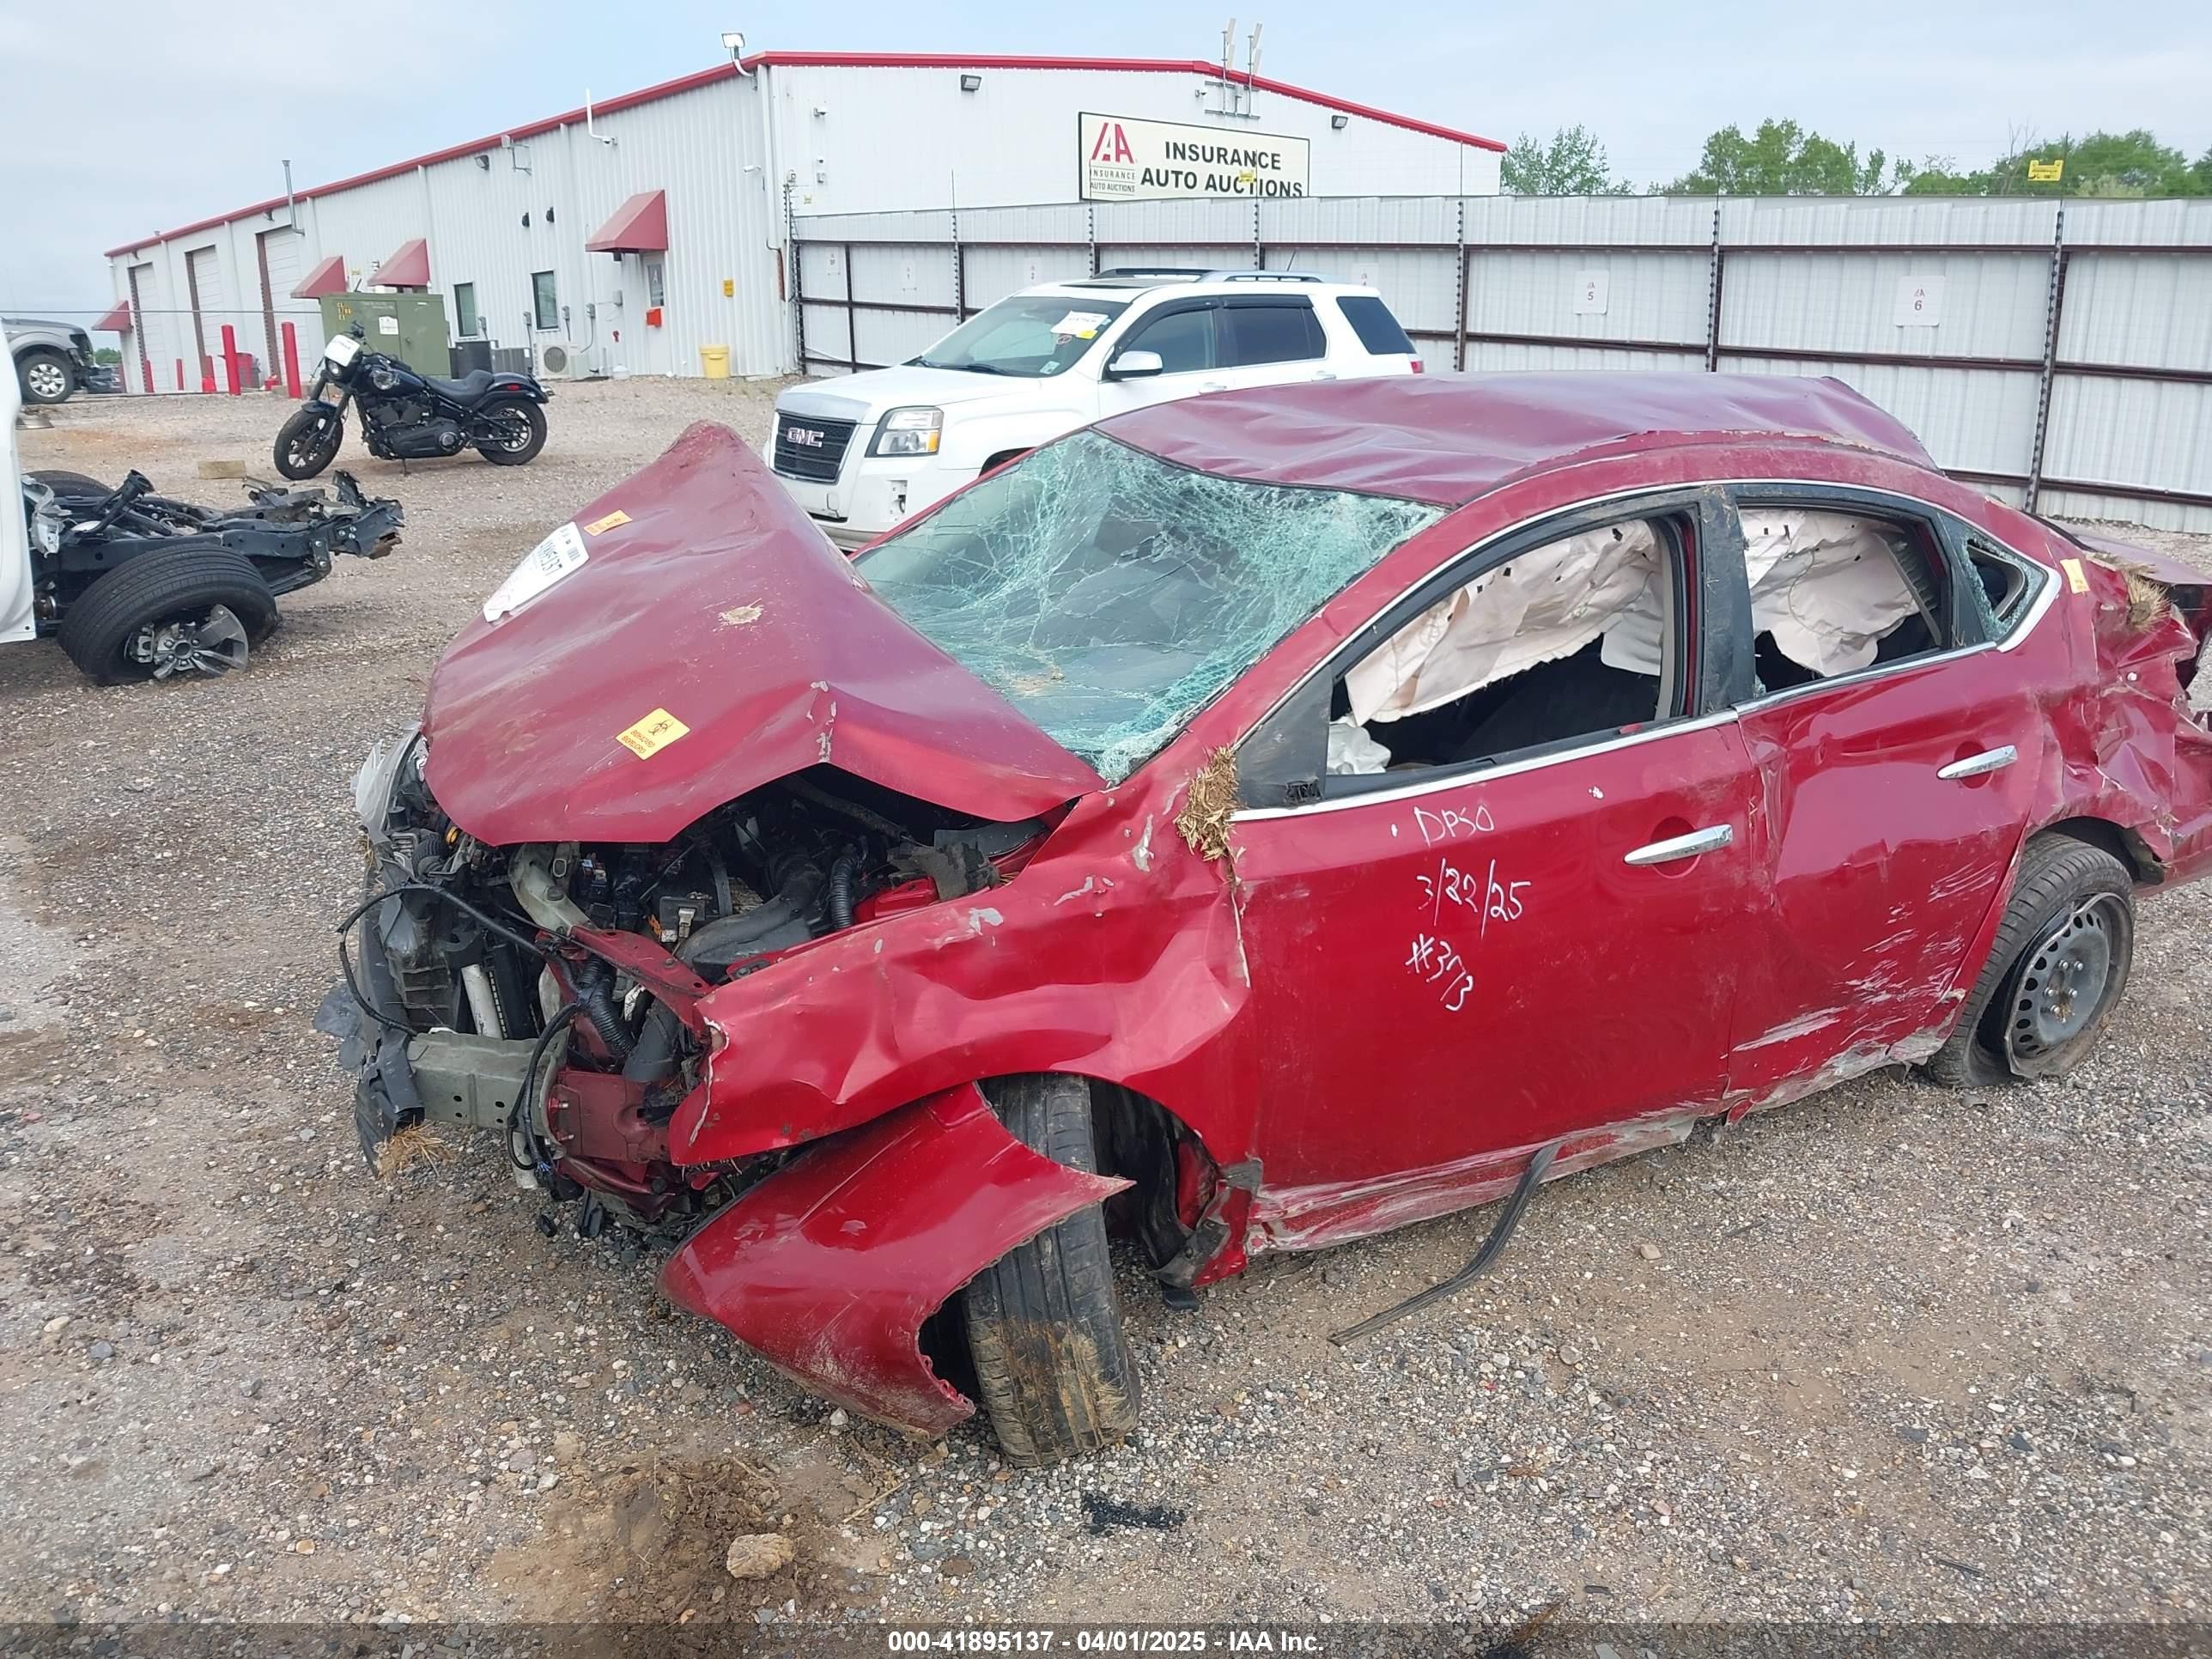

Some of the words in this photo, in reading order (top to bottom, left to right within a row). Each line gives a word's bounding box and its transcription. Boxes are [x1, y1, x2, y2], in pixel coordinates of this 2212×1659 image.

[1165, 142, 1281, 170] INSURANCE
[1092, 168, 1135, 180] NSURANCE
[1141, 167, 1197, 189] AUTO
[1205, 173, 1303, 198] AUCTIONS
[1107, 183, 1135, 193] AUCTIONS
[1587, 291, 1595, 301] 5
[1914, 300, 1923, 311] 6
[787, 427, 824, 448] GMC
[1413, 805, 1495, 848] DPSO
[1416, 858, 1531, 940] 3/22/25
